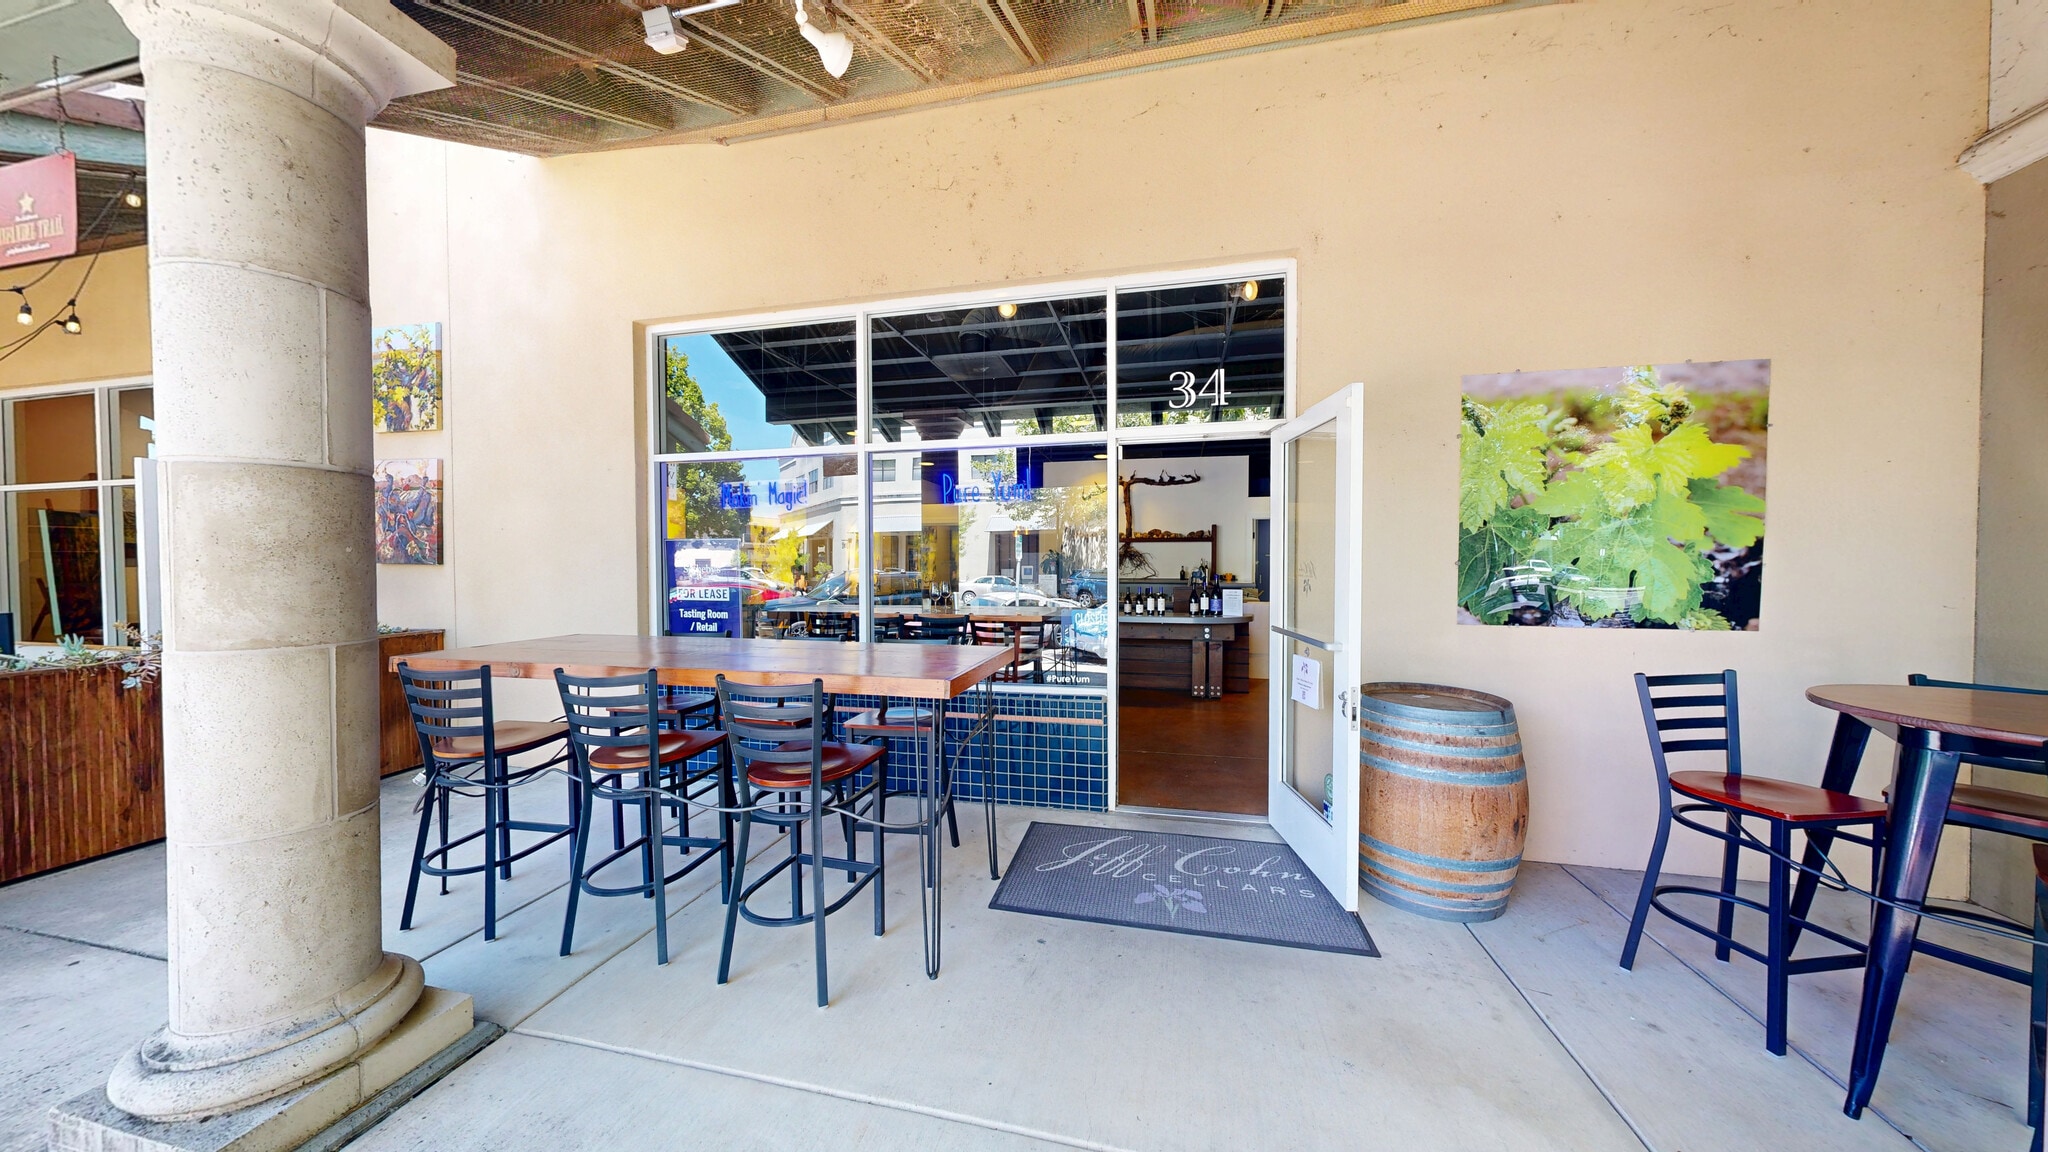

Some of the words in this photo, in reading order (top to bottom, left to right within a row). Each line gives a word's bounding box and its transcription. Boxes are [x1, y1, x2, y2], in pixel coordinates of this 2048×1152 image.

[1168, 368, 1232, 409] 34
[942, 473, 980, 504] Pure
[991, 468, 1032, 502] Yum!
[698, 588, 728, 599] LEASE
[679, 608, 706, 620] Tasting
[707, 609, 729, 619] Room
[696, 622, 718, 632] Retail
[1046, 674, 1090, 683] #PureYum
[1035, 835, 1167, 878] Jeff
[1174, 845, 1307, 880] Cohn
[1142, 873, 1316, 898] CELLARS
